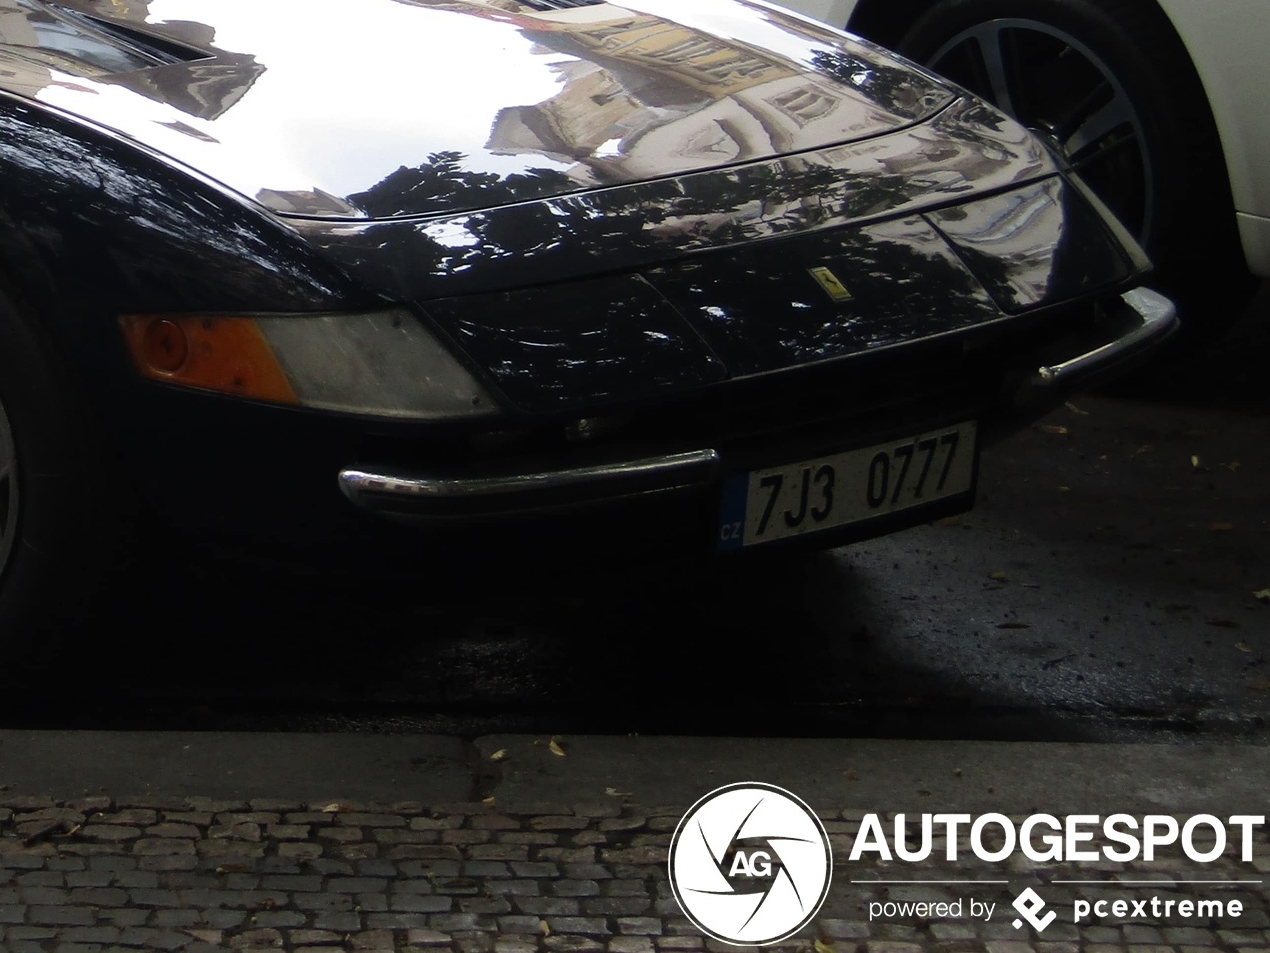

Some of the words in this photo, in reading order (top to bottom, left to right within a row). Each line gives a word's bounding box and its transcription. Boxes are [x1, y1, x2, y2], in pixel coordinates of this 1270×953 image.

[756, 464, 835, 535] 7J3
[866, 430, 960, 508] 0777
[720, 521, 741, 541] CZ
